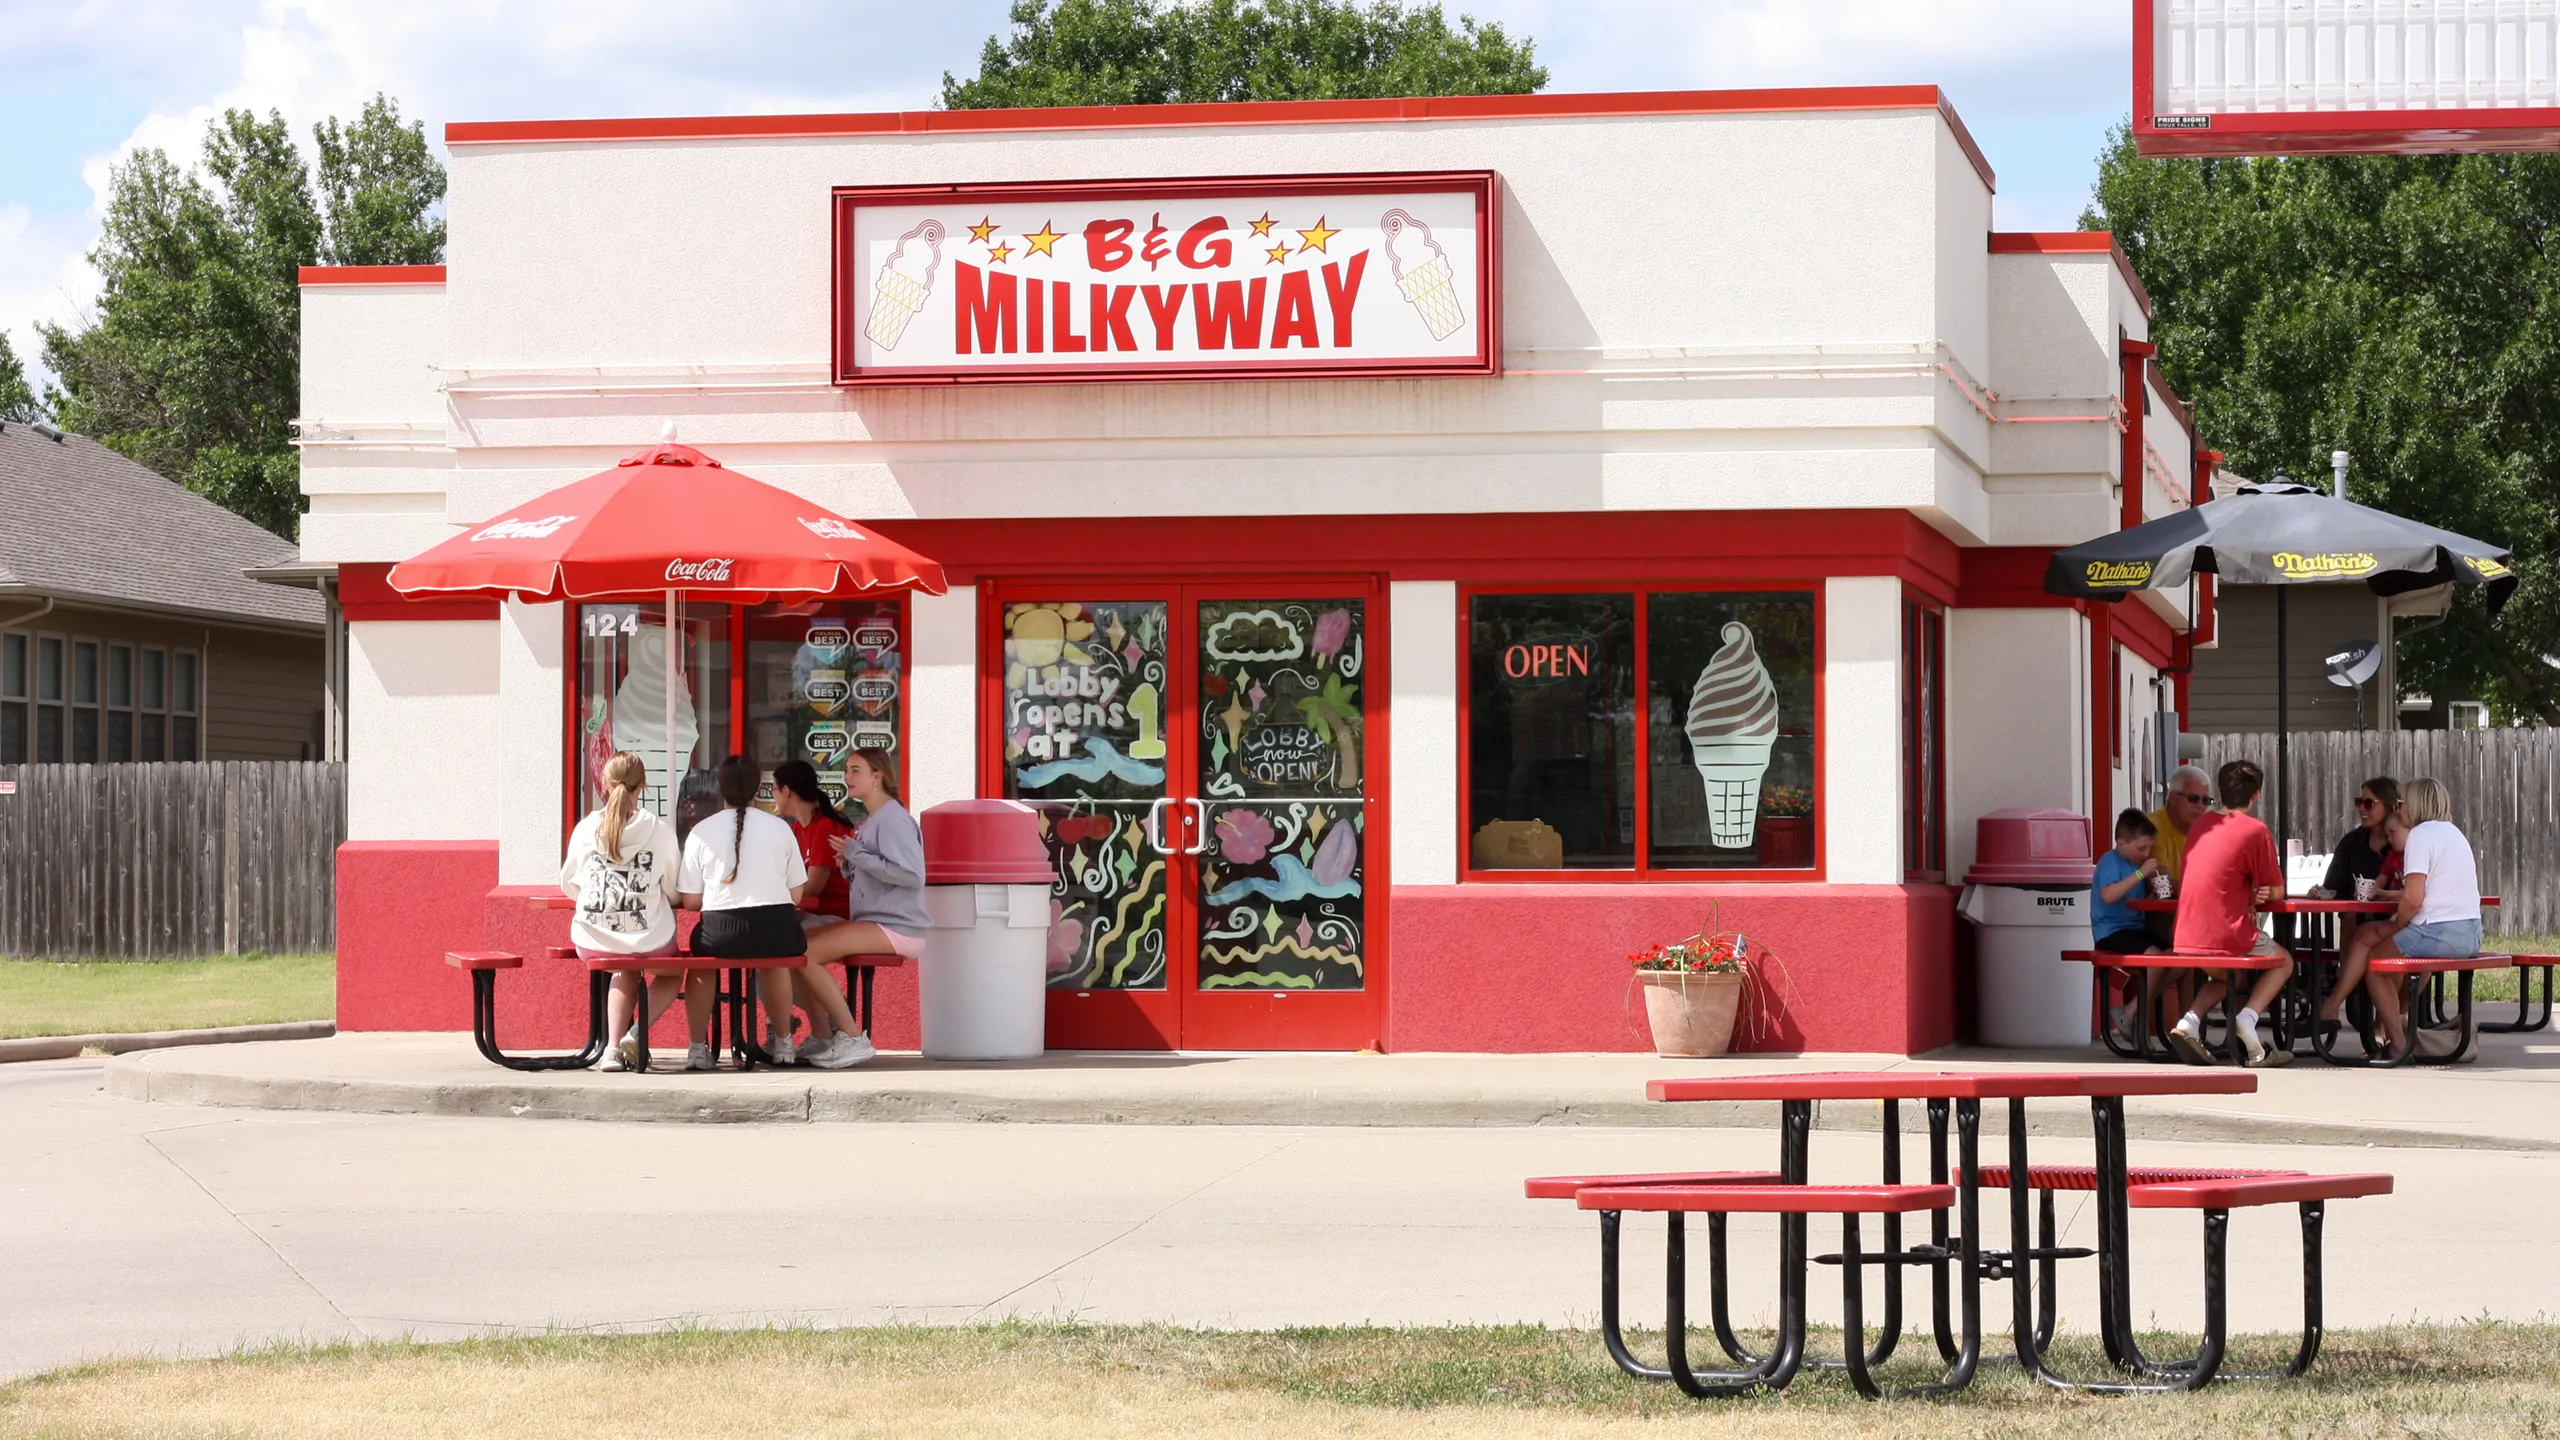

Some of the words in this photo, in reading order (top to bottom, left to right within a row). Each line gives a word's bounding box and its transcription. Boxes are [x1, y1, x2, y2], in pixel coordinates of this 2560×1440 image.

[1083, 212, 1233, 272] B&G
[955, 248, 1370, 355] MILKYWAY
[664, 557, 735, 582] Coca-Cola
[2086, 561, 2152, 581] Nathan's
[2271, 552, 2376, 573] Nathan's
[584, 613, 638, 637] 124
[814, 636, 842, 644] BEST
[862, 636, 889, 644] BEST
[1504, 645, 1588, 678] OPEN
[813, 688, 841, 697] BEST
[861, 687, 889, 696] BEST
[1027, 666, 1121, 706] Lobby
[1026, 701, 1125, 735] opens
[1126, 683, 1166, 759] 1
[814, 739, 841, 748] BEST
[860, 739, 887, 748] BEST
[1027, 728, 1079, 760] at
[1253, 748, 1313, 762] now
[2037, 897, 2076, 906] BRUTE
